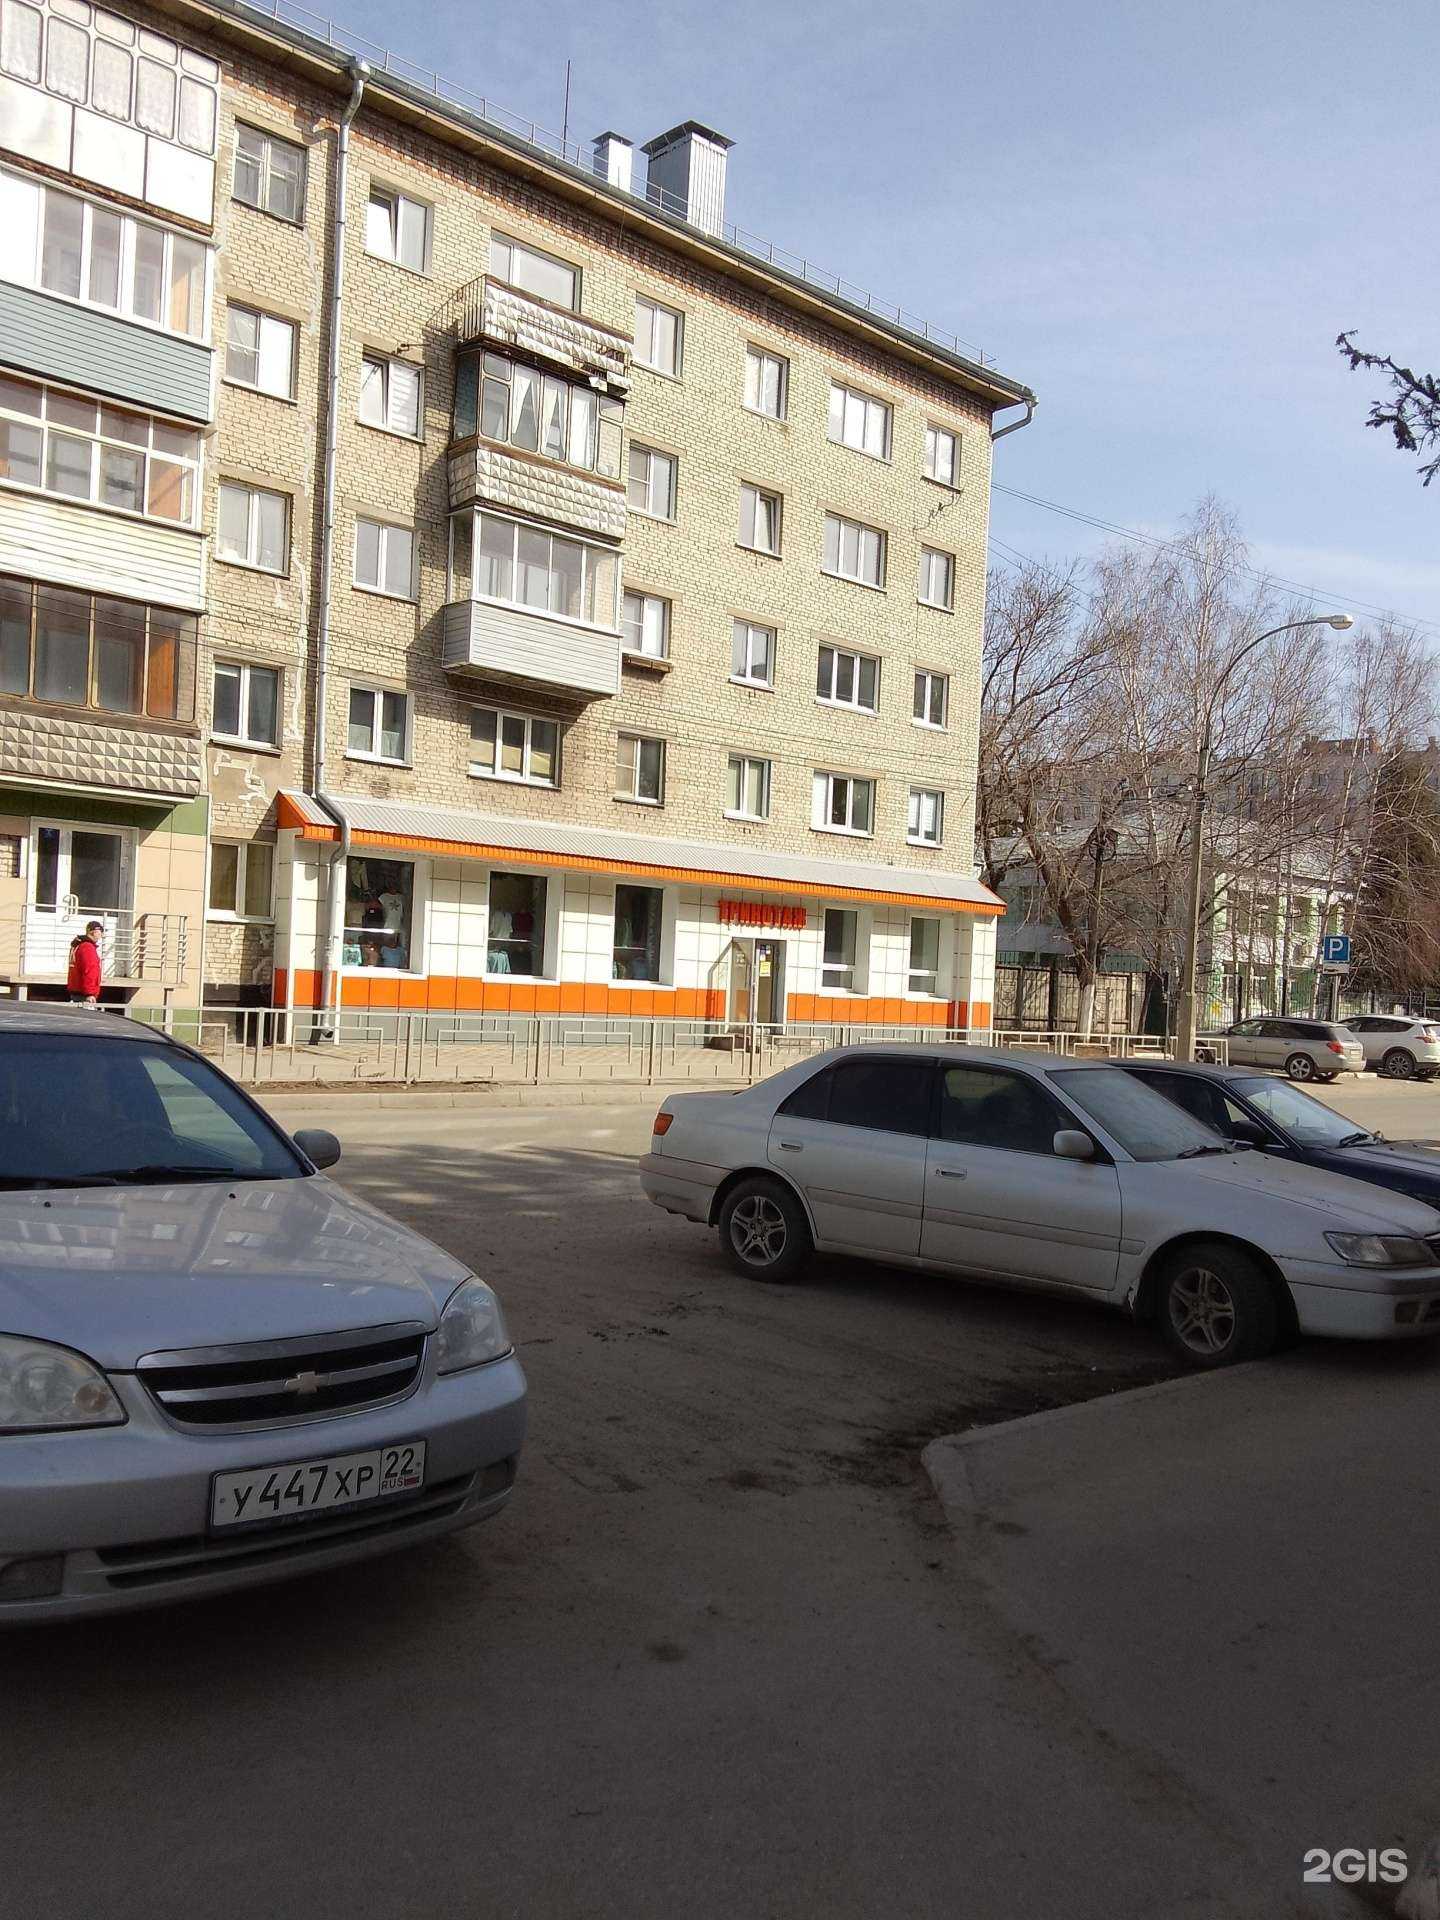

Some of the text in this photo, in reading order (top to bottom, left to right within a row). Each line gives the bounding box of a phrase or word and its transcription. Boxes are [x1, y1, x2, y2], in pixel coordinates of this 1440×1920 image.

[1329, 938, 1344, 959] P
[233, 1465, 374, 1518] У447ХР
[385, 1448, 415, 1479] 22
[381, 1478, 404, 1490] RUS
